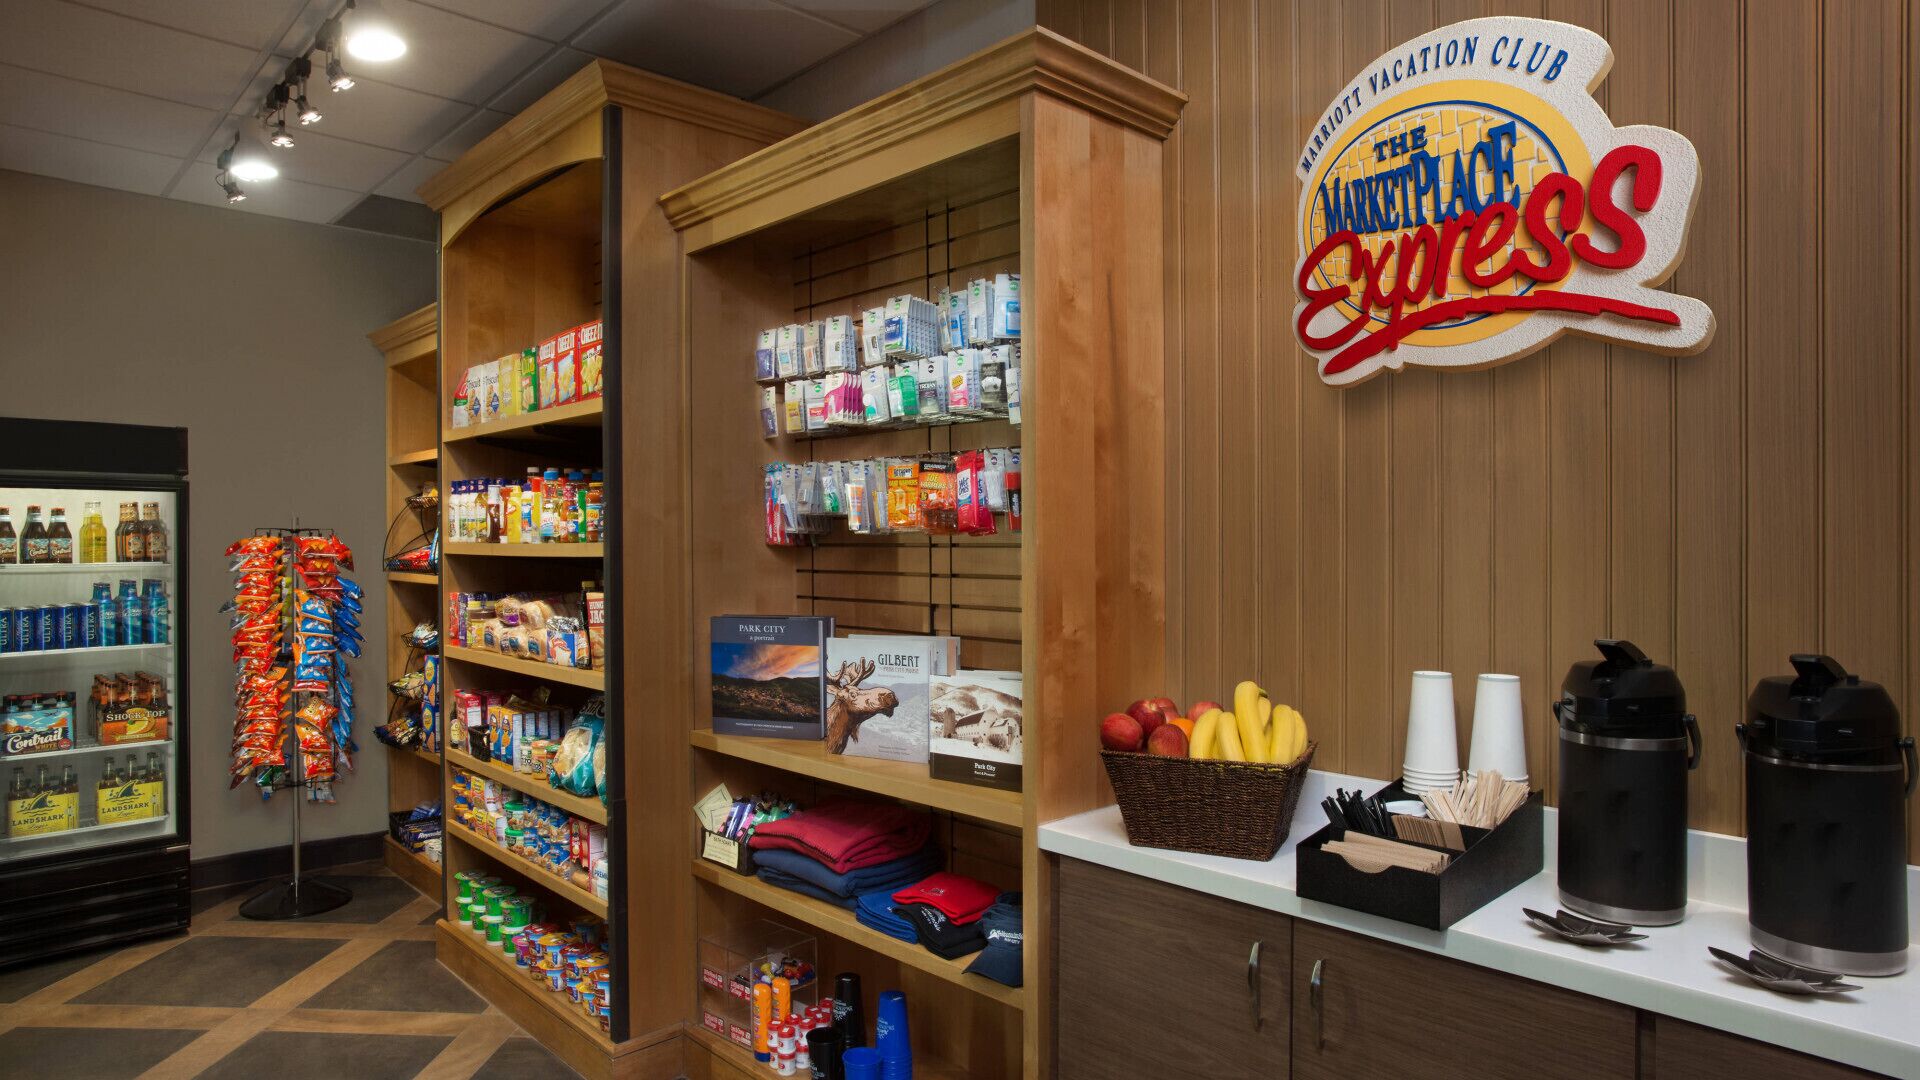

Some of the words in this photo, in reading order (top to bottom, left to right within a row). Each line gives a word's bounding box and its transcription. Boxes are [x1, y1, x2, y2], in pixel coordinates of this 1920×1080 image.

[1300, 87, 1361, 174] MARRIOTT
[1369, 36, 1479, 91] VACATION
[1491, 36, 1569, 82] CLUB
[1373, 125, 1428, 162] THE
[1298, 144, 1663, 352] Express
[590, 610, 604, 624] JAC
[739, 624, 761, 633] PARK
[763, 625, 786, 634] CITY
[878, 653, 920, 668] GILBERT
[106, 712, 141, 722] SHOCK
[146, 710, 166, 718] TOP
[7, 728, 63, 753] Contrail
[101, 802, 149, 814] LANDSHARK
[12, 813, 65, 826] LANDSHARK
